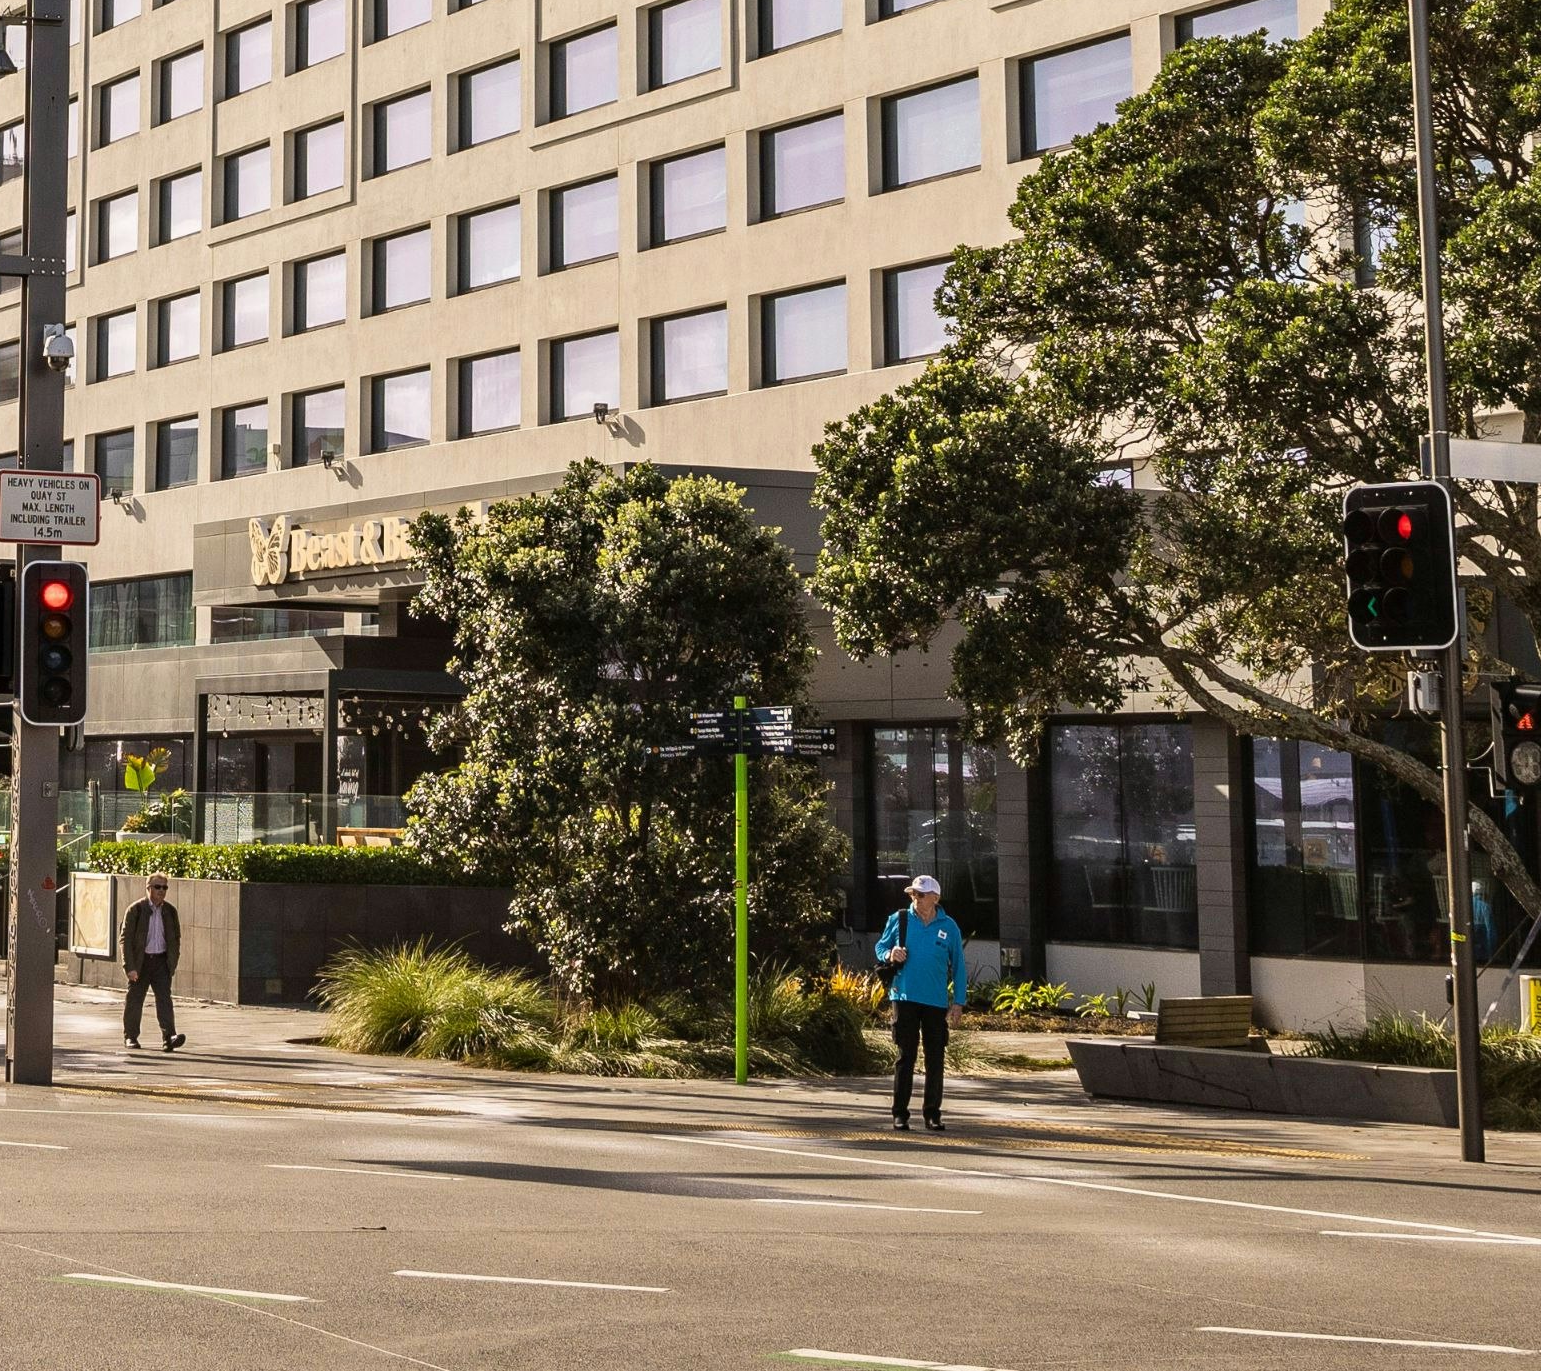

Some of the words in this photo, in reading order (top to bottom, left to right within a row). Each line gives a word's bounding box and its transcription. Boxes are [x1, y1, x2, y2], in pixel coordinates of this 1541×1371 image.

[7, 477, 34, 488] HEAVY
[38, 479, 75, 489] VEHICLES
[79, 481, 90, 490] ON
[31, 491, 53, 501] QUAY
[57, 492, 66, 501] ST
[22, 502, 41, 513] MAX.
[45, 503, 75, 513] LENGTH
[10, 514, 50, 525] INCLUDING
[54, 516, 86, 526] TRAILER
[33, 527, 62, 538] 14.5m
